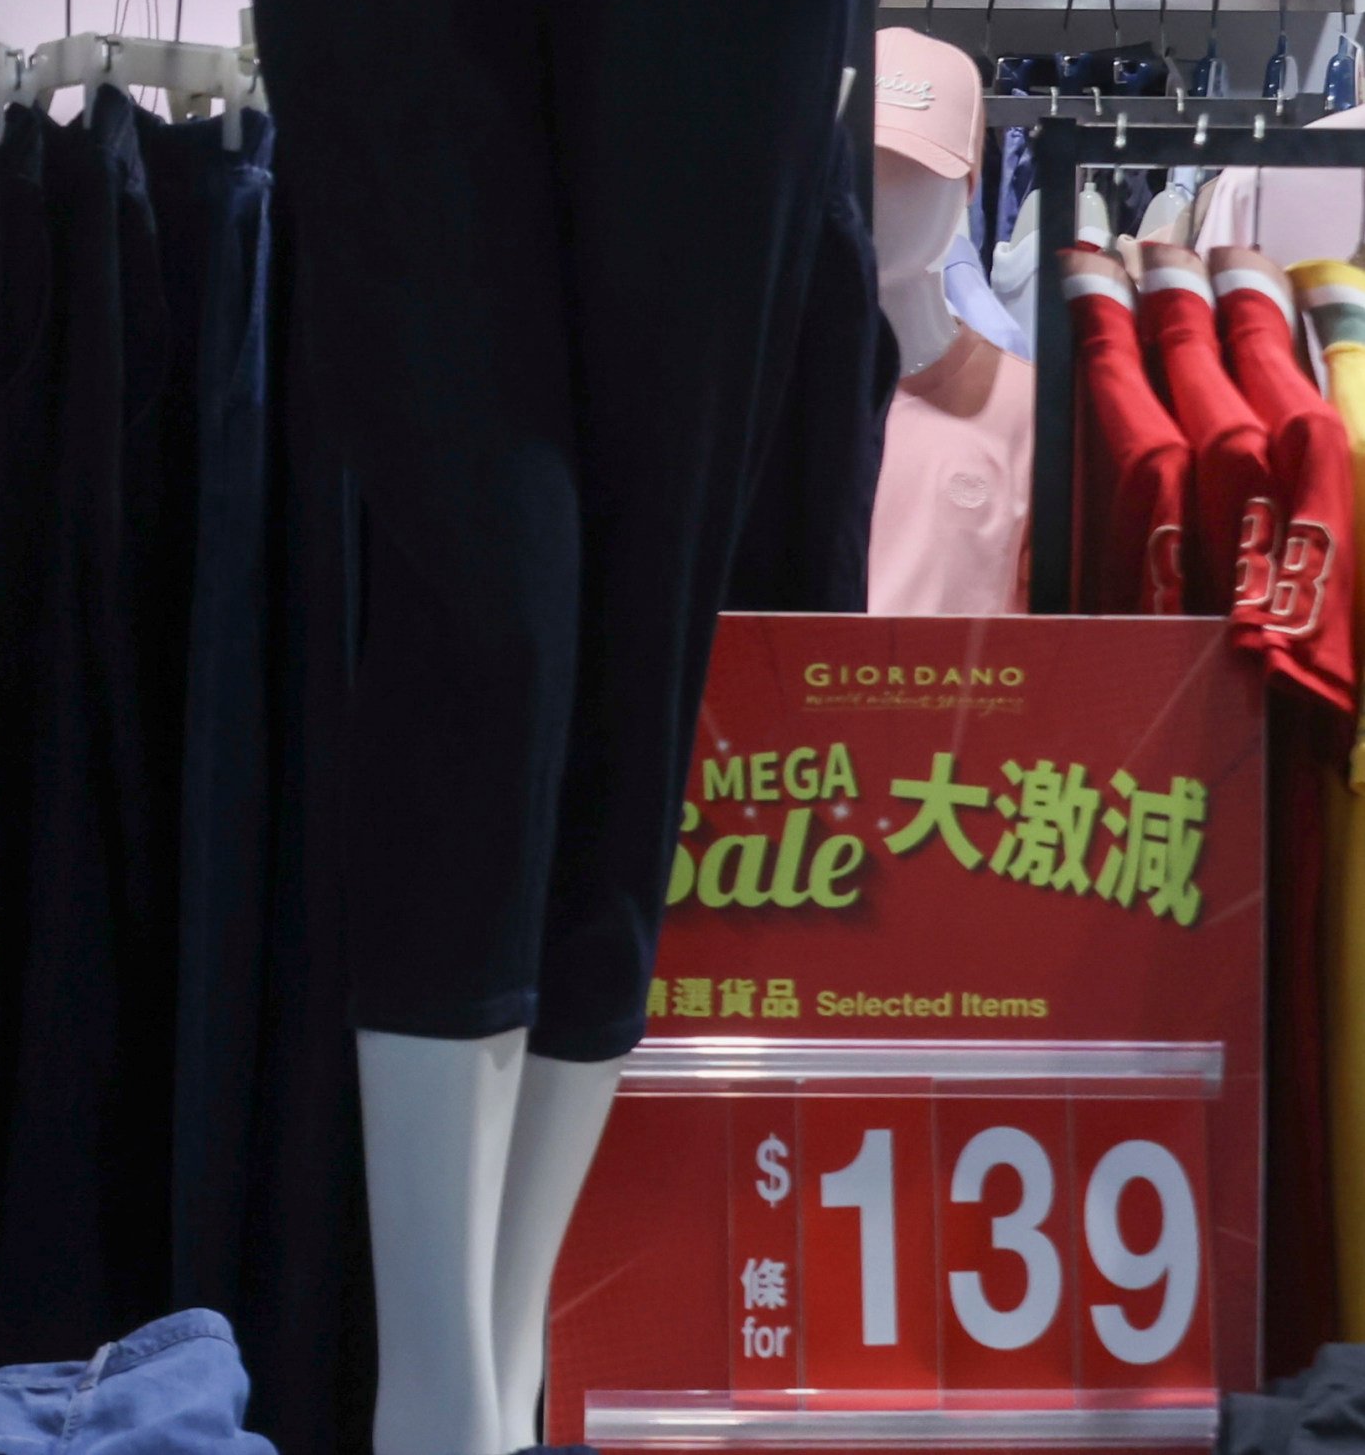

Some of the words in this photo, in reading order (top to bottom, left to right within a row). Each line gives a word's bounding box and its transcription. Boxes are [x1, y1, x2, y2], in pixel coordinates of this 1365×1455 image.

[804, 662, 1026, 687] GIORDANO
[702, 742, 859, 801] MEGA
[883, 751, 1207, 926] 大激減
[816, 990, 954, 1018] Selected
[960, 991, 1049, 1018] Items
[755, 1132, 792, 1208] $
[820, 1126, 1200, 1365] 139
[740, 1257, 789, 1310] 條
[741, 1316, 792, 1359] for
